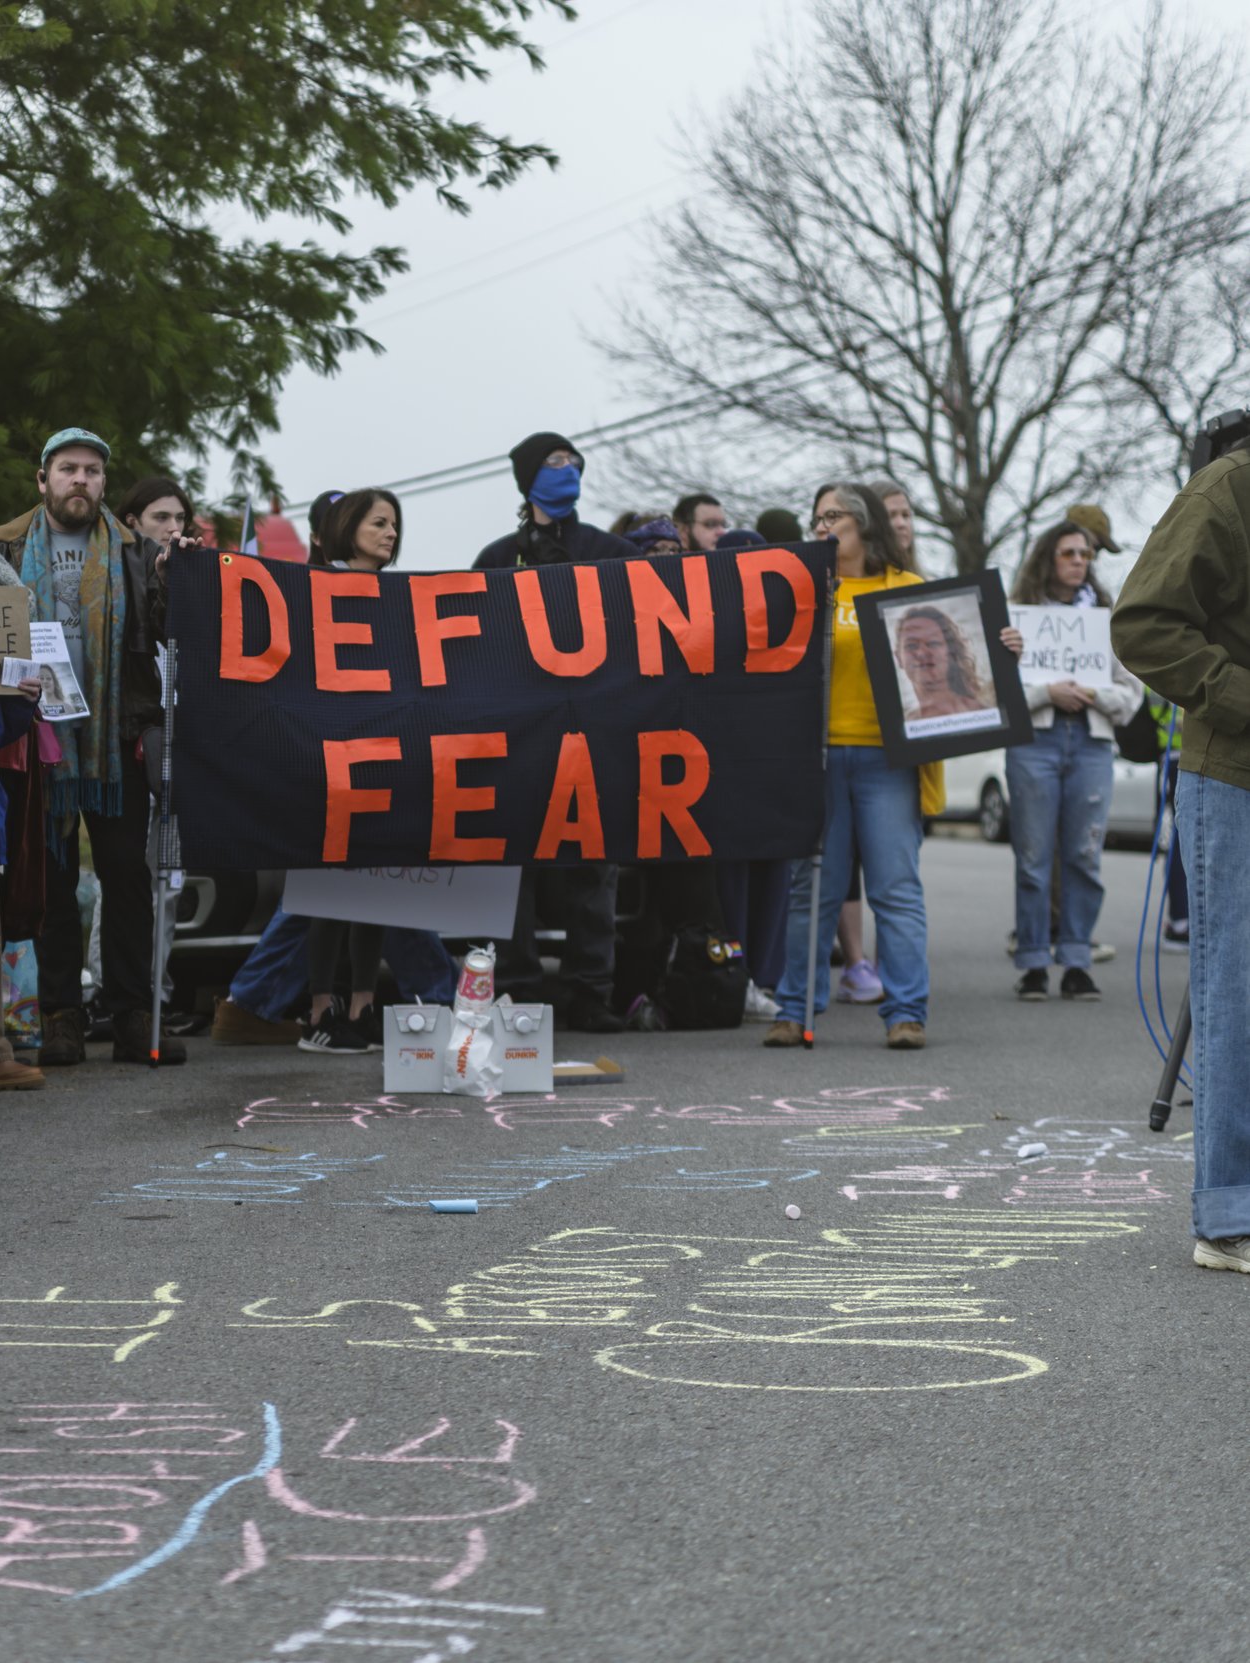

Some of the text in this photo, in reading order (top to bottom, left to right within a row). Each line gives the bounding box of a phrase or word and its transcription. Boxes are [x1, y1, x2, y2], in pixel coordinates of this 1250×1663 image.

[218, 547, 817, 693] DEFUND
[1035, 613, 1087, 643] AM
[321, 728, 714, 863] FEAR
[224, 1297, 423, 1328] IS
[220, 1417, 538, 1591] ICE
